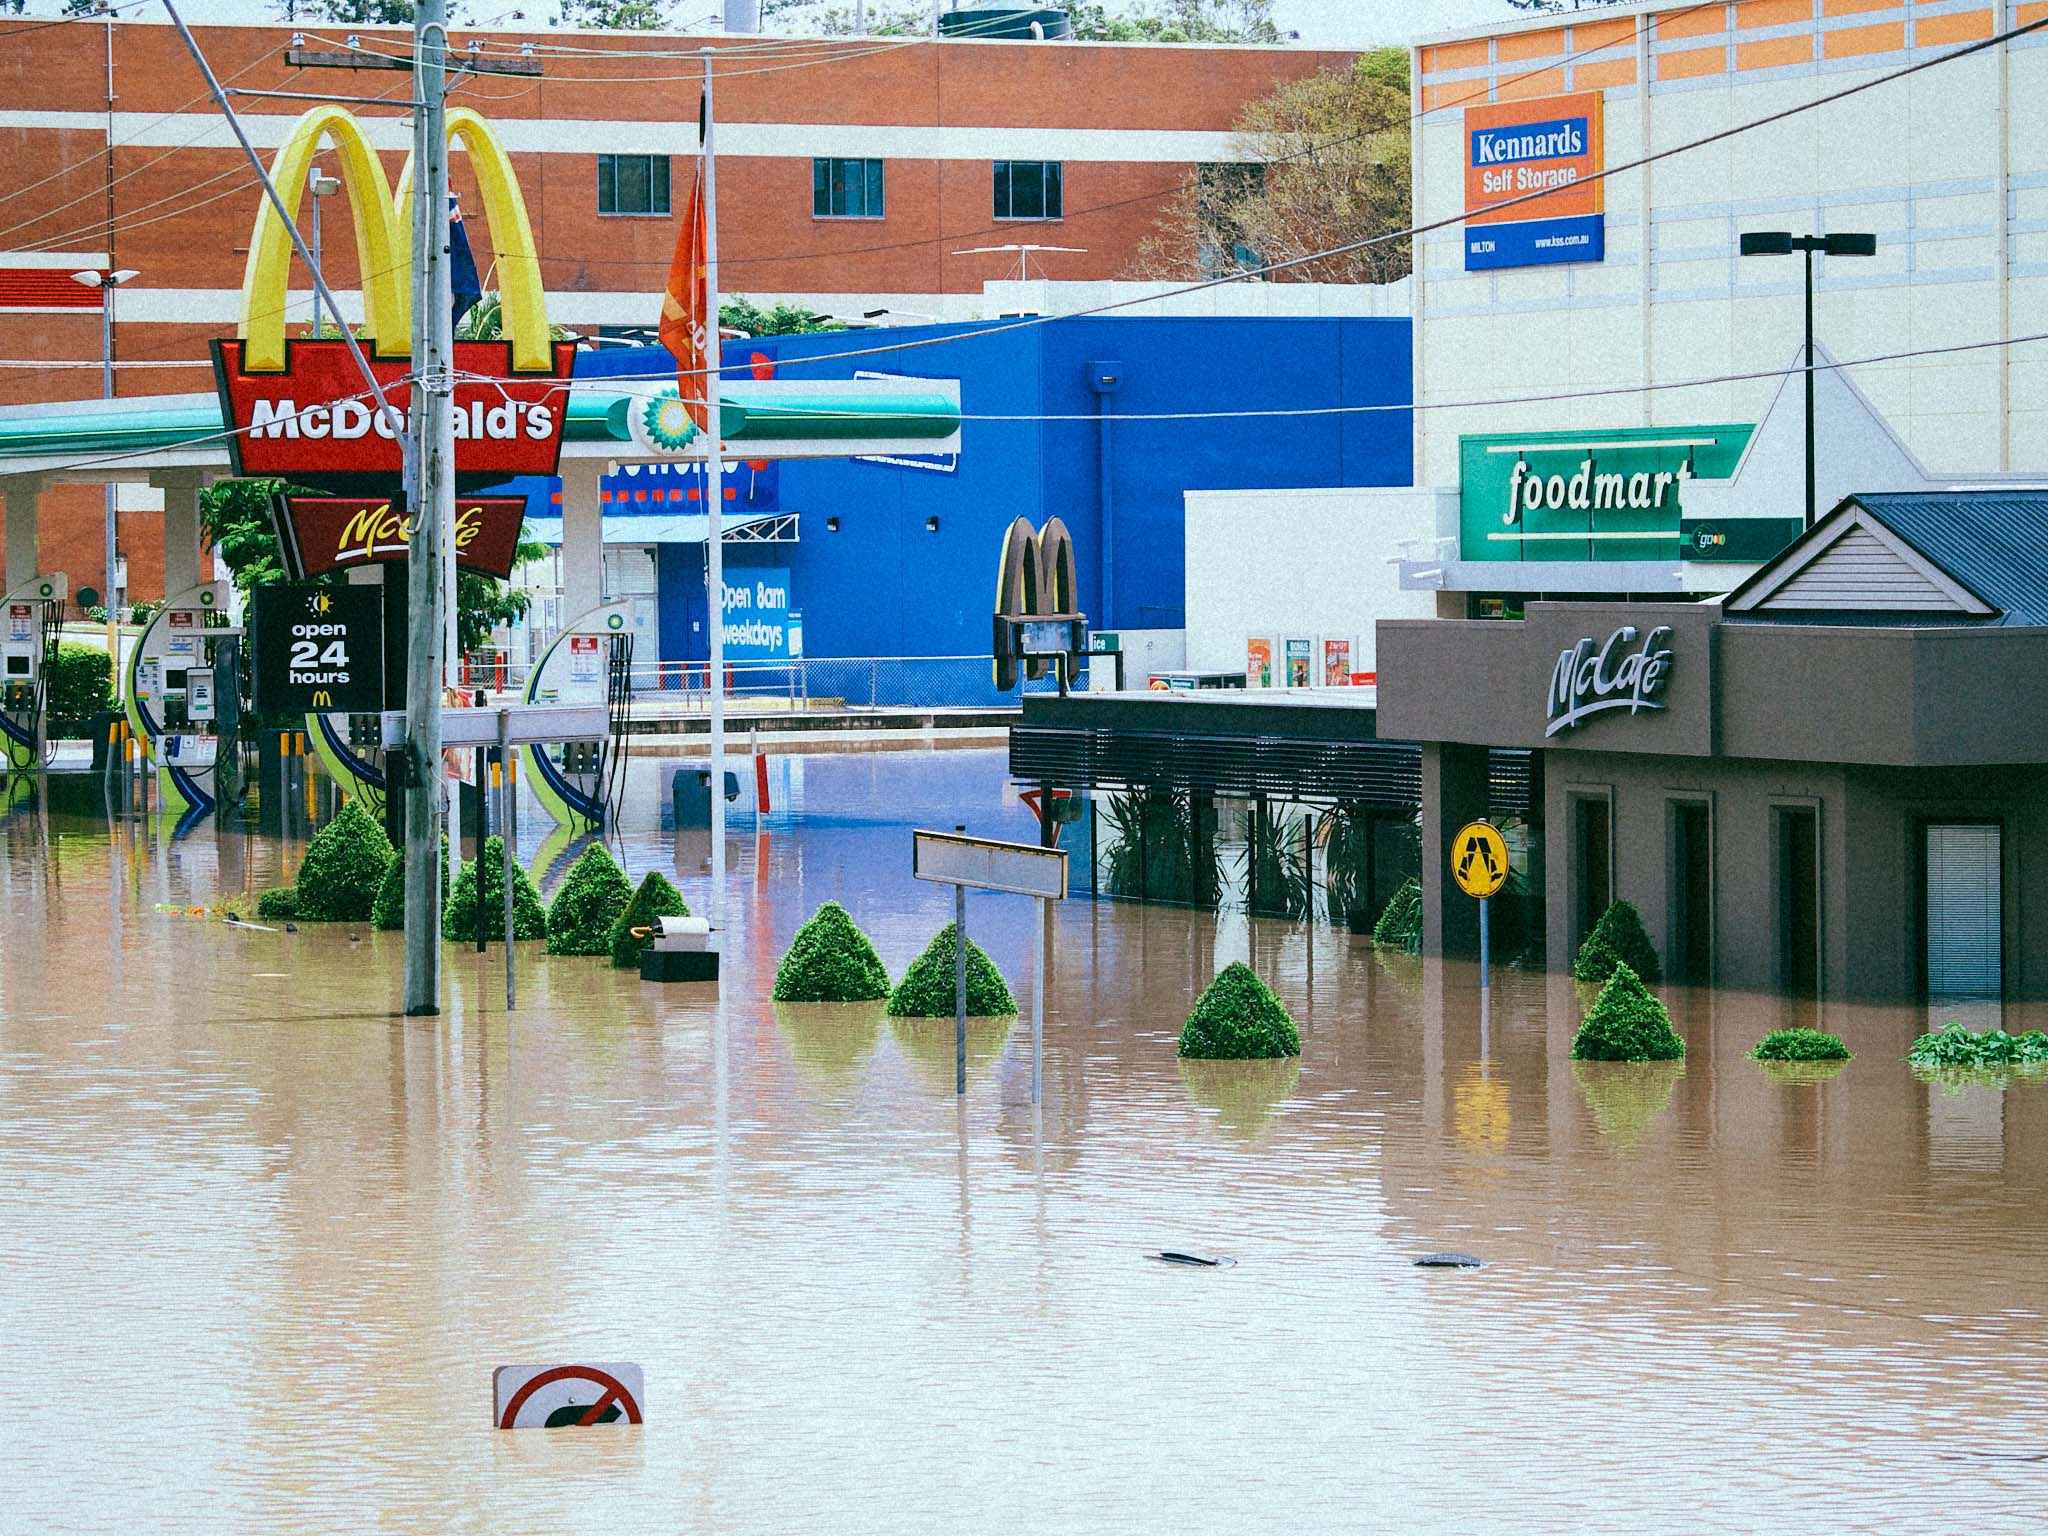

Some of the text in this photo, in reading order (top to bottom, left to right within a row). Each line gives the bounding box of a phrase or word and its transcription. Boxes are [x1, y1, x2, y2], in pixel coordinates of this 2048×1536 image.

[1478, 124, 1582, 163] Kennards
[1482, 166, 1578, 194] Self Storage
[1471, 234, 1589, 254] MILTON www.kss.com.au
[249, 399, 553, 440] McDoald's
[1502, 459, 1693, 526] foodmart
[338, 504, 483, 558] Mcfé
[756, 580, 786, 610] 8am
[291, 624, 347, 640] open
[721, 618, 783, 653] weekdays
[1093, 635, 1106, 650] ice
[289, 640, 350, 668] 24
[289, 669, 350, 684] hours
[1546, 624, 1674, 728] McCafé
